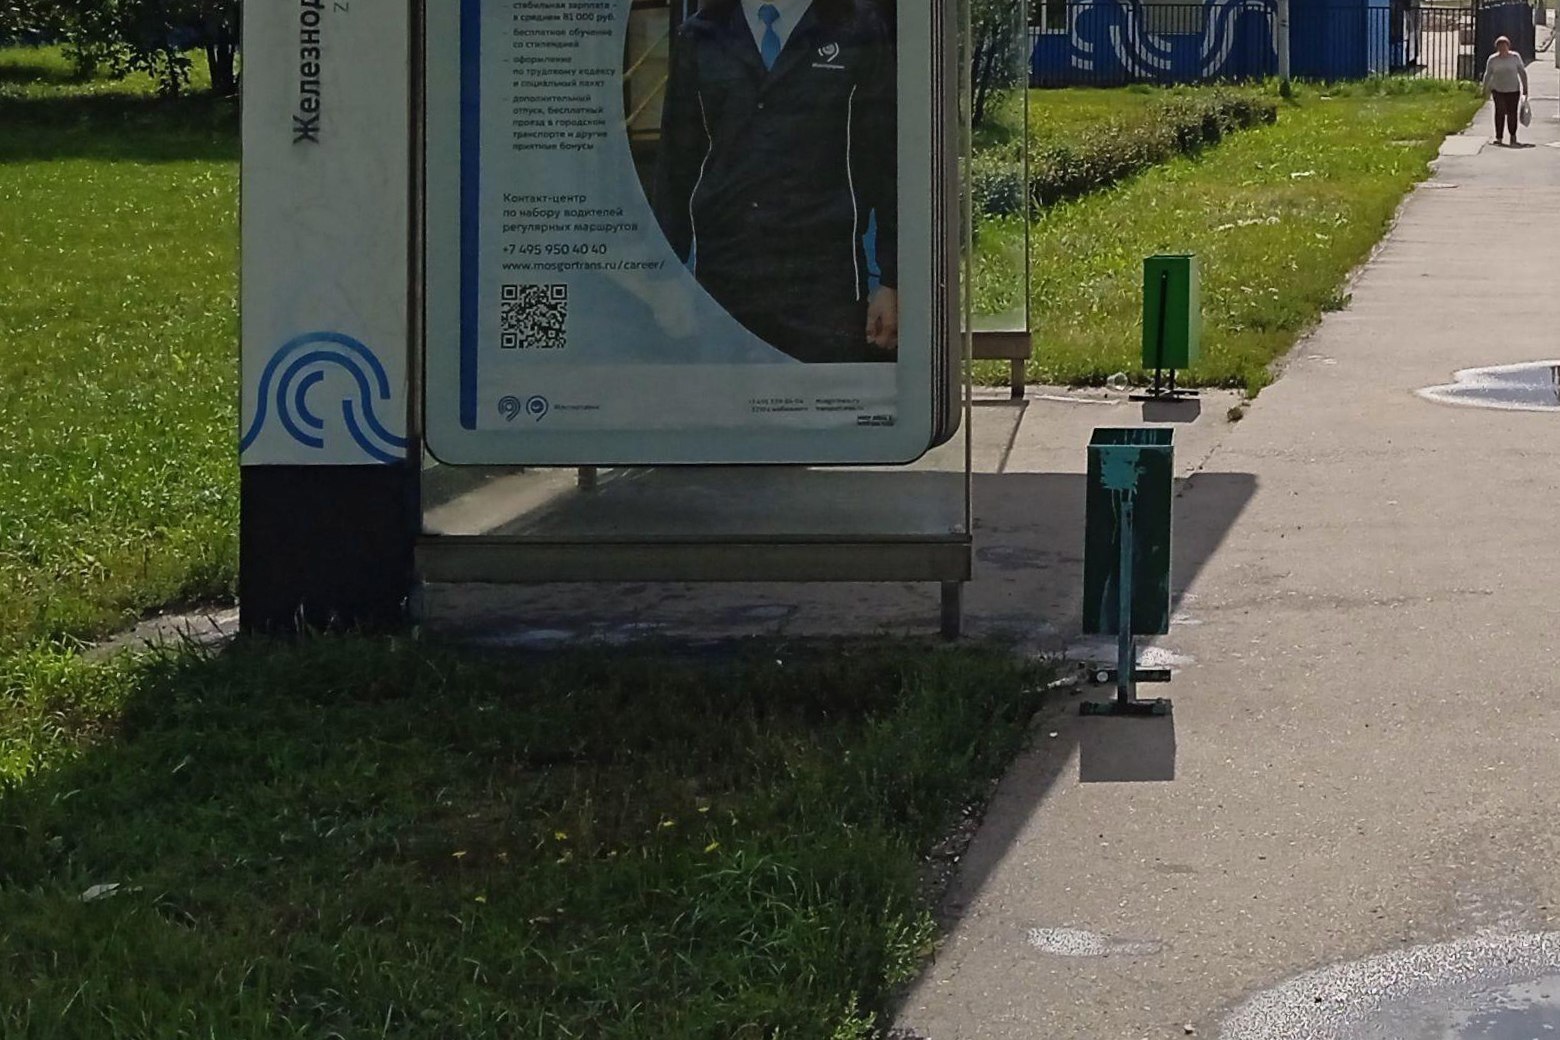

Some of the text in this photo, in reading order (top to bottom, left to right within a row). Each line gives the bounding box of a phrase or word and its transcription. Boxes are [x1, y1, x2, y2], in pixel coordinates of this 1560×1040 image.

[559, 142, 594, 151] бонусы
[503, 193, 587, 204] Контакт-центр
[519, 207, 561, 219] набору
[563, 207, 623, 218] водителей
[502, 222, 638, 234] регулярных маршрутов
[503, 244, 607, 255] +7 495 950 40 40
[502, 259, 665, 272] www.mosgortrans.ru/career/
